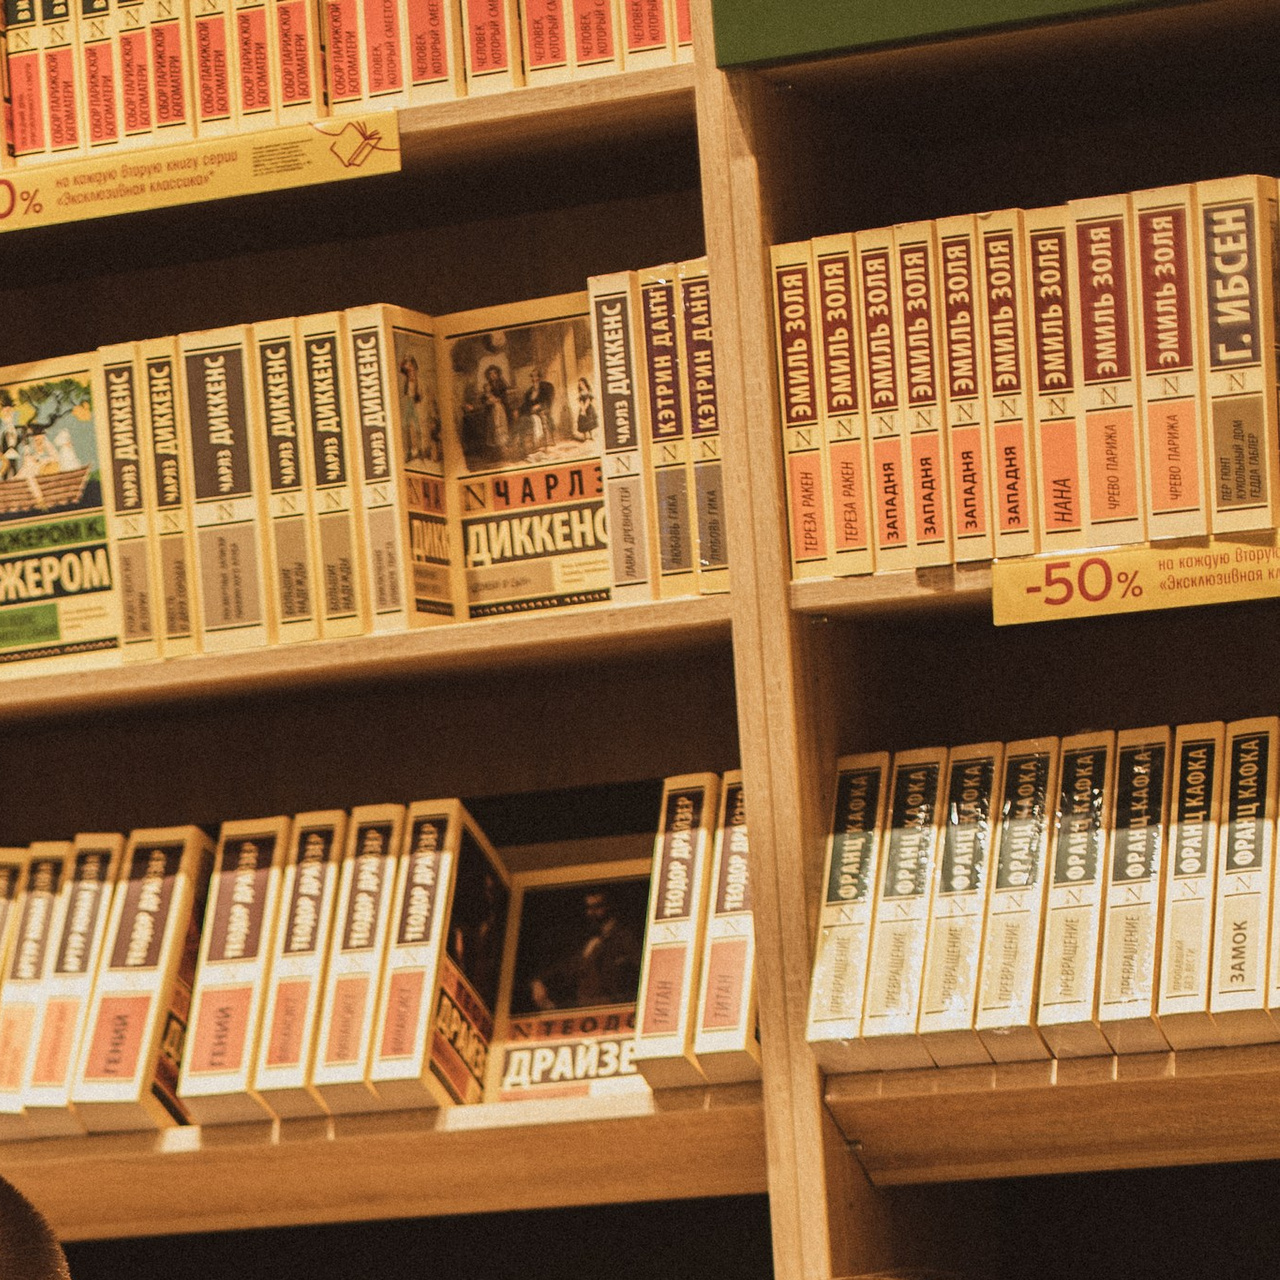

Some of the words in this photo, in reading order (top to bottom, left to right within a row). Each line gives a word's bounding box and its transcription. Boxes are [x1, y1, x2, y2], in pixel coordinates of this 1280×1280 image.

[1038, 238, 1062, 299] ЗОЛЯ
[1090, 227, 1114, 287] ЗОЛЯ
[1152, 216, 1175, 278] ЗОЛЯ
[1212, 208, 1252, 325] ИБСЕН
[782, 274, 805, 333] ЗОЛЯ
[824, 262, 847, 322] ЗОЛЯ
[904, 252, 927, 312] ЗОЛЯ
[690, 284, 714, 341] ДАНН
[1094, 293, 1118, 374] ЭМИЛЬ
[1156, 282, 1179, 366] ЭМИЛЬ
[602, 302, 631, 396] ДИККЕНС
[828, 328, 853, 407] ЭМИЛЬ
[908, 317, 933, 399] ЭМИЛЬ
[1042, 304, 1066, 386] ЭМИЛЬ
[1219, 334, 1253, 362] Г.
[205, 355, 234, 446] ДИККЕНС
[266, 347, 295, 438] ДИККЕНС
[357, 337, 386, 427] ДИККЕНС
[654, 355, 676, 434] КЭТРИН
[694, 350, 717, 429] КЭТРИН
[787, 338, 811, 418] ЭМИЛЬ
[110, 371, 139, 460] ДИККЕНС
[614, 400, 630, 444] ЧАРЛЗ
[1166, 414, 1181, 461] ПАРИЖА
[1232, 419, 1245, 442] ДОМ
[217, 449, 233, 492] ЧАРЛЗ
[279, 442, 296, 484] ЧАРЛЗ
[370, 432, 387, 474] ЧАРЛЗ
[1104, 424, 1118, 472] ПАРИЖА
[121, 464, 138, 506] ЧАРЛЗ
[800, 471, 815, 508] РАКЕН
[841, 461, 856, 499] РАКЕН
[882, 462, 899, 540] ЗАПАДНЯ
[920, 457, 936, 535] ЗАПАДНЯ
[961, 450, 978, 529] ЗАПАДНЯ
[1004, 446, 1021, 525] ЗАПАДНЯ
[1052, 478, 1073, 523] НАНА
[1106, 475, 1121, 510] ЧРЕВО
[1167, 465, 1182, 500] ЧРЕВО
[803, 511, 818, 552] ТЕРЕЗА
[843, 502, 858, 542] ТЕРЕЗА
[1026, 557, 1144, 606] -50%
[1158, 557, 1174, 571] на
[1179, 550, 1231, 570] каждую
[1159, 567, 1263, 592] «Эксклюзивная
[1073, 754, 1095, 814] КАФКА
[1186, 748, 1207, 808] КАФКА
[1238, 740, 1260, 800] КАФКА
[846, 775, 868, 834] КАФКА
[1233, 803, 1257, 866] ФРАНЦ
[838, 836, 866, 899] ФРАНЦ
[1066, 816, 1092, 880] ФРАНЦ
[1180, 811, 1207, 873] ФРАНЦ
[1230, 920, 1248, 983] ЗАМОК
